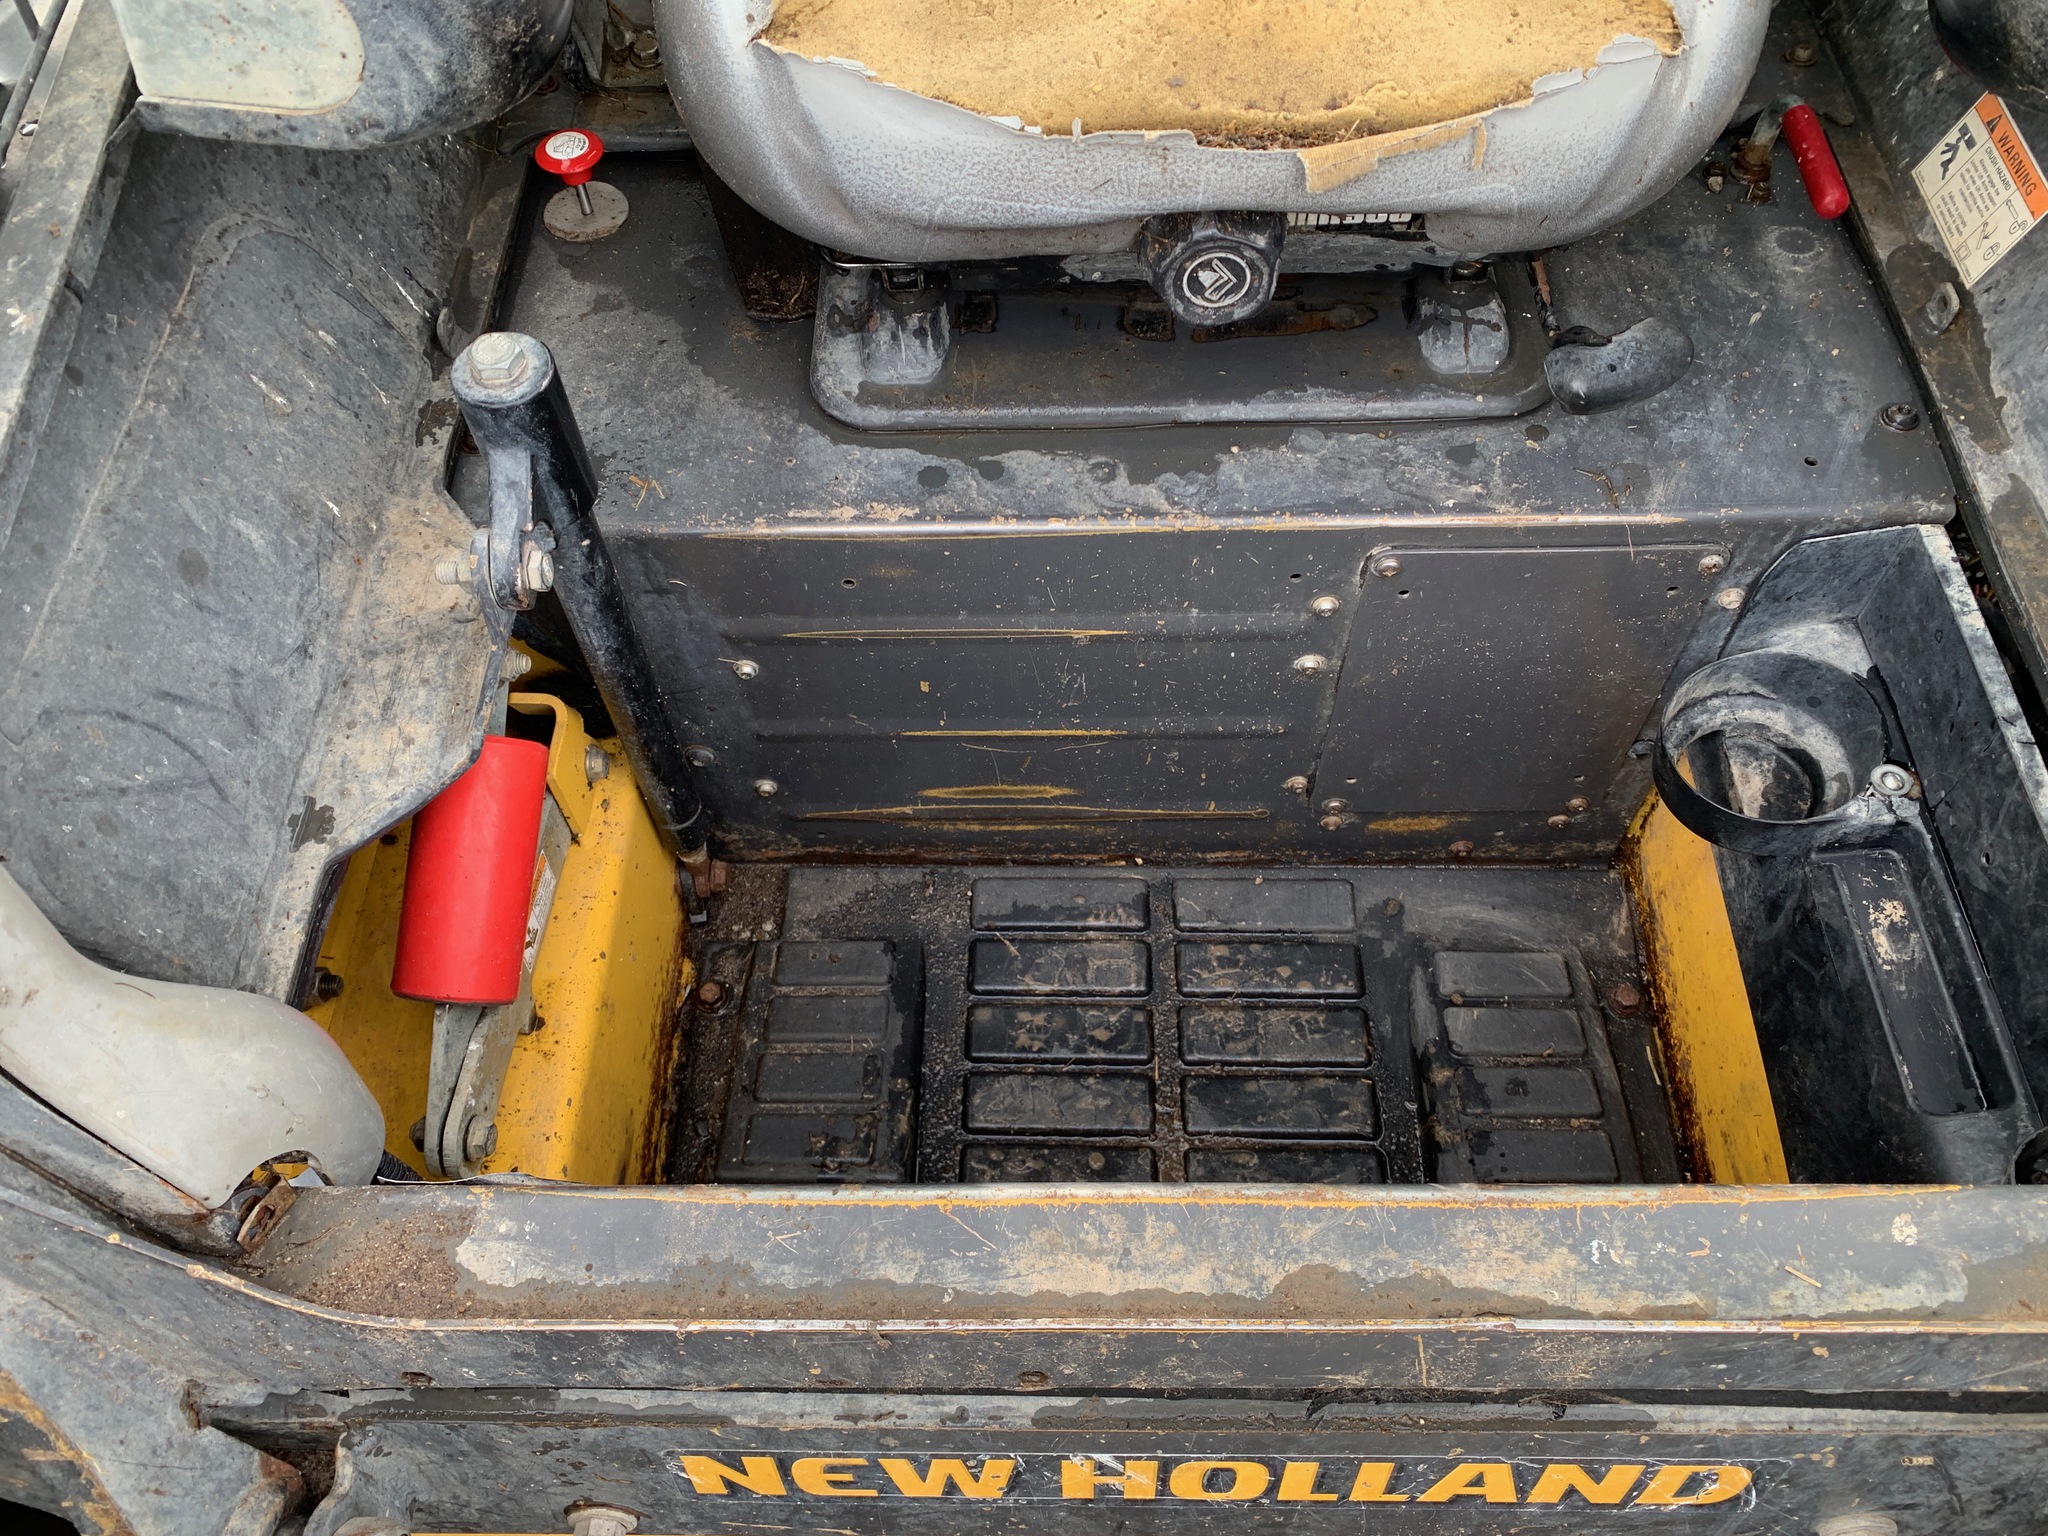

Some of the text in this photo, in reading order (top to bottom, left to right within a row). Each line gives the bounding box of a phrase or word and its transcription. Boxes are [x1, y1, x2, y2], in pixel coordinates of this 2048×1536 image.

[1984, 145, 2011, 192] CRUSH HAZARD
[1996, 130, 2037, 197] WARNING
[678, 1455, 1754, 1506] NEW HOLLAND
